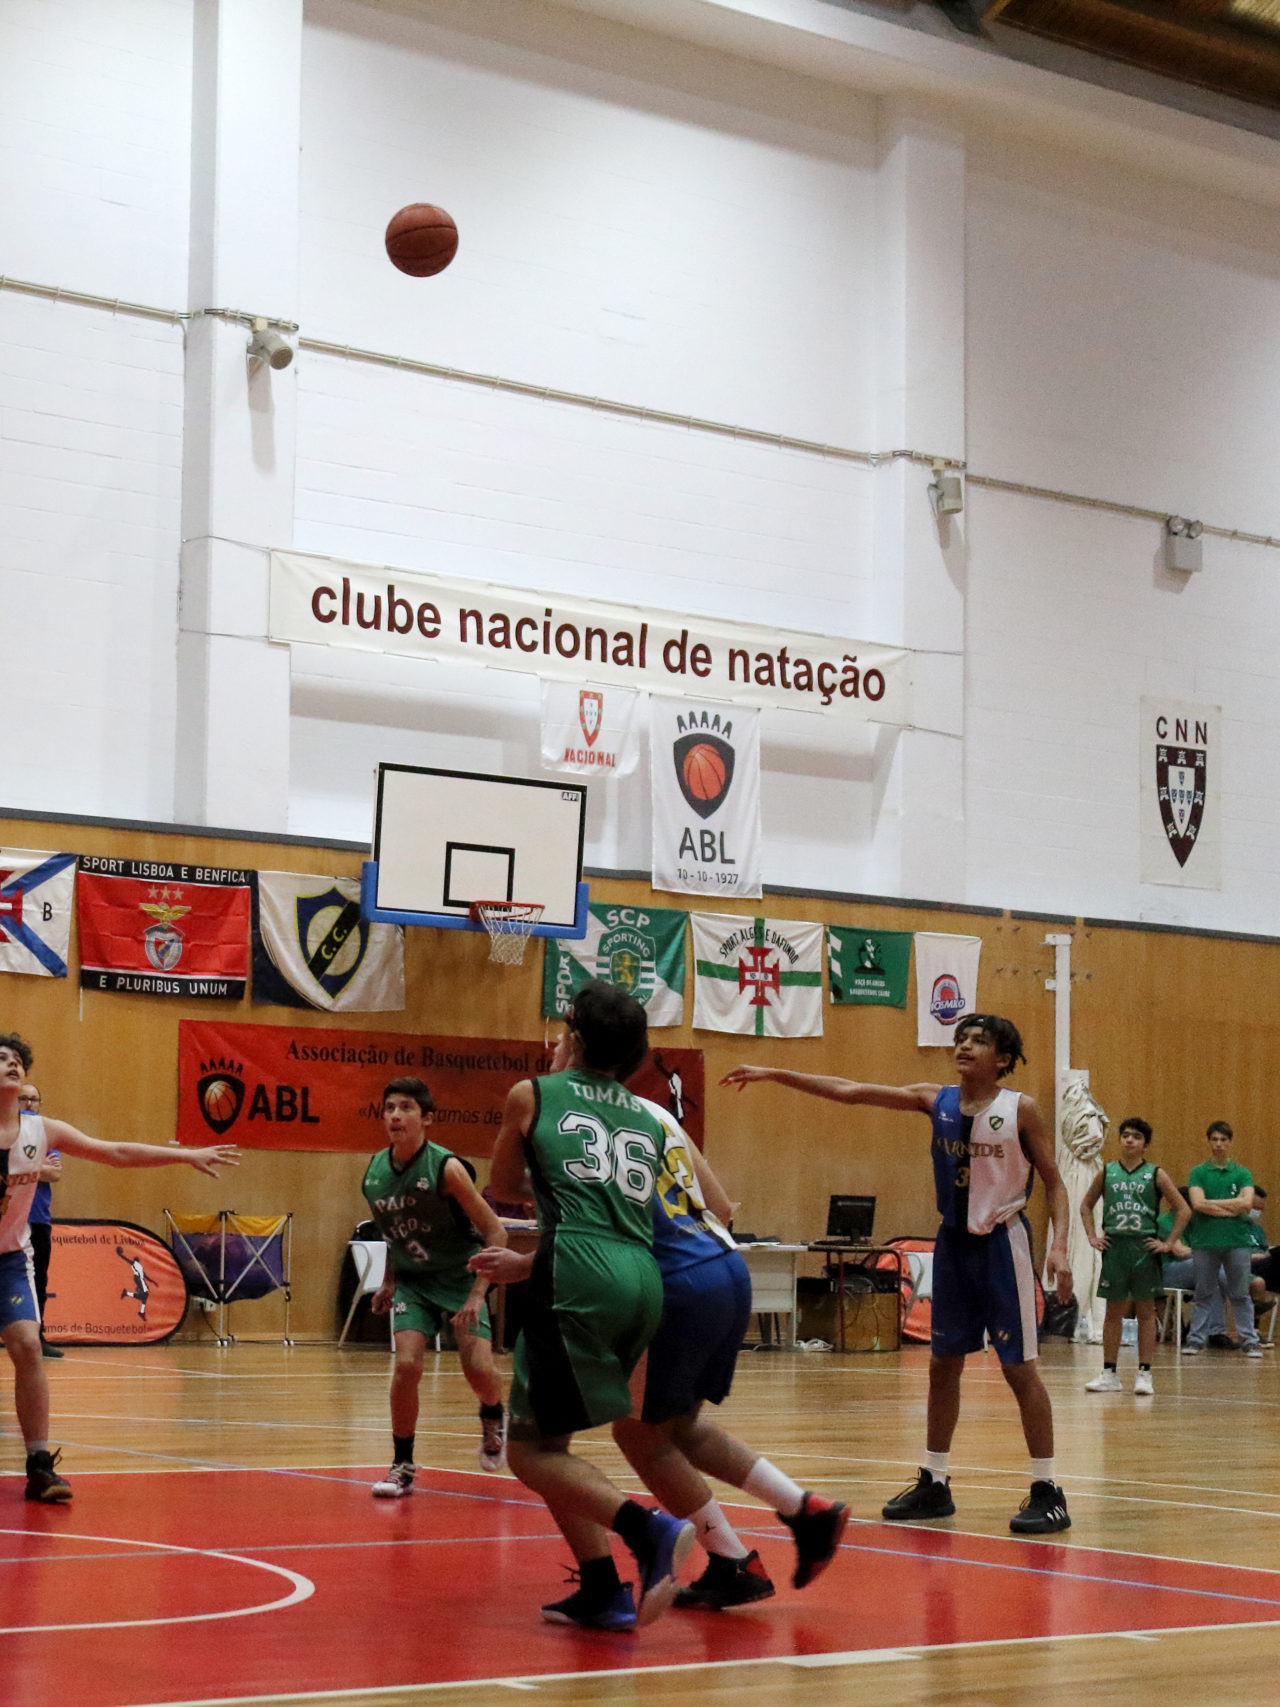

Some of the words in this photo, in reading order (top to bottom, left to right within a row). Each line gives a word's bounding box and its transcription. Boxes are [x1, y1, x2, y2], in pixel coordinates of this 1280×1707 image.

[312, 576, 442, 639] clube
[460, 608, 648, 669] nacional
[662, 629, 713, 678] de
[728, 648, 886, 706] natação
[1155, 716, 1208, 745] CNN
[564, 747, 616, 768] NACIONAL
[678, 826, 736, 865] ABL
[82, 856, 125, 873] SPORT
[131, 862, 175, 878] LISBOA
[181, 866, 189, 879] E
[195, 868, 247, 884] BENFICA
[42, 901, 53, 922] B
[606, 908, 651, 928] SCP
[601, 932, 652, 958] SPORTING
[719, 931, 740, 960] SPORT
[765, 929, 770, 941] E
[772, 931, 800, 965] DAFUNDO
[99, 975, 107, 988] E
[117, 977, 180, 994] PLURIBUS
[189, 982, 228, 995] UNUM
[285, 1039, 389, 1068] Associação
[394, 1045, 415, 1067] de
[421, 1047, 530, 1075] Basquetebol
[247, 1083, 321, 1124] ABL
[483, 1106, 503, 1124] de
[557, 1110, 658, 1208] 36
[1115, 1214, 1142, 1230] 23
[100, 1235, 113, 1245] de
[72, 1322, 83, 1333] de
